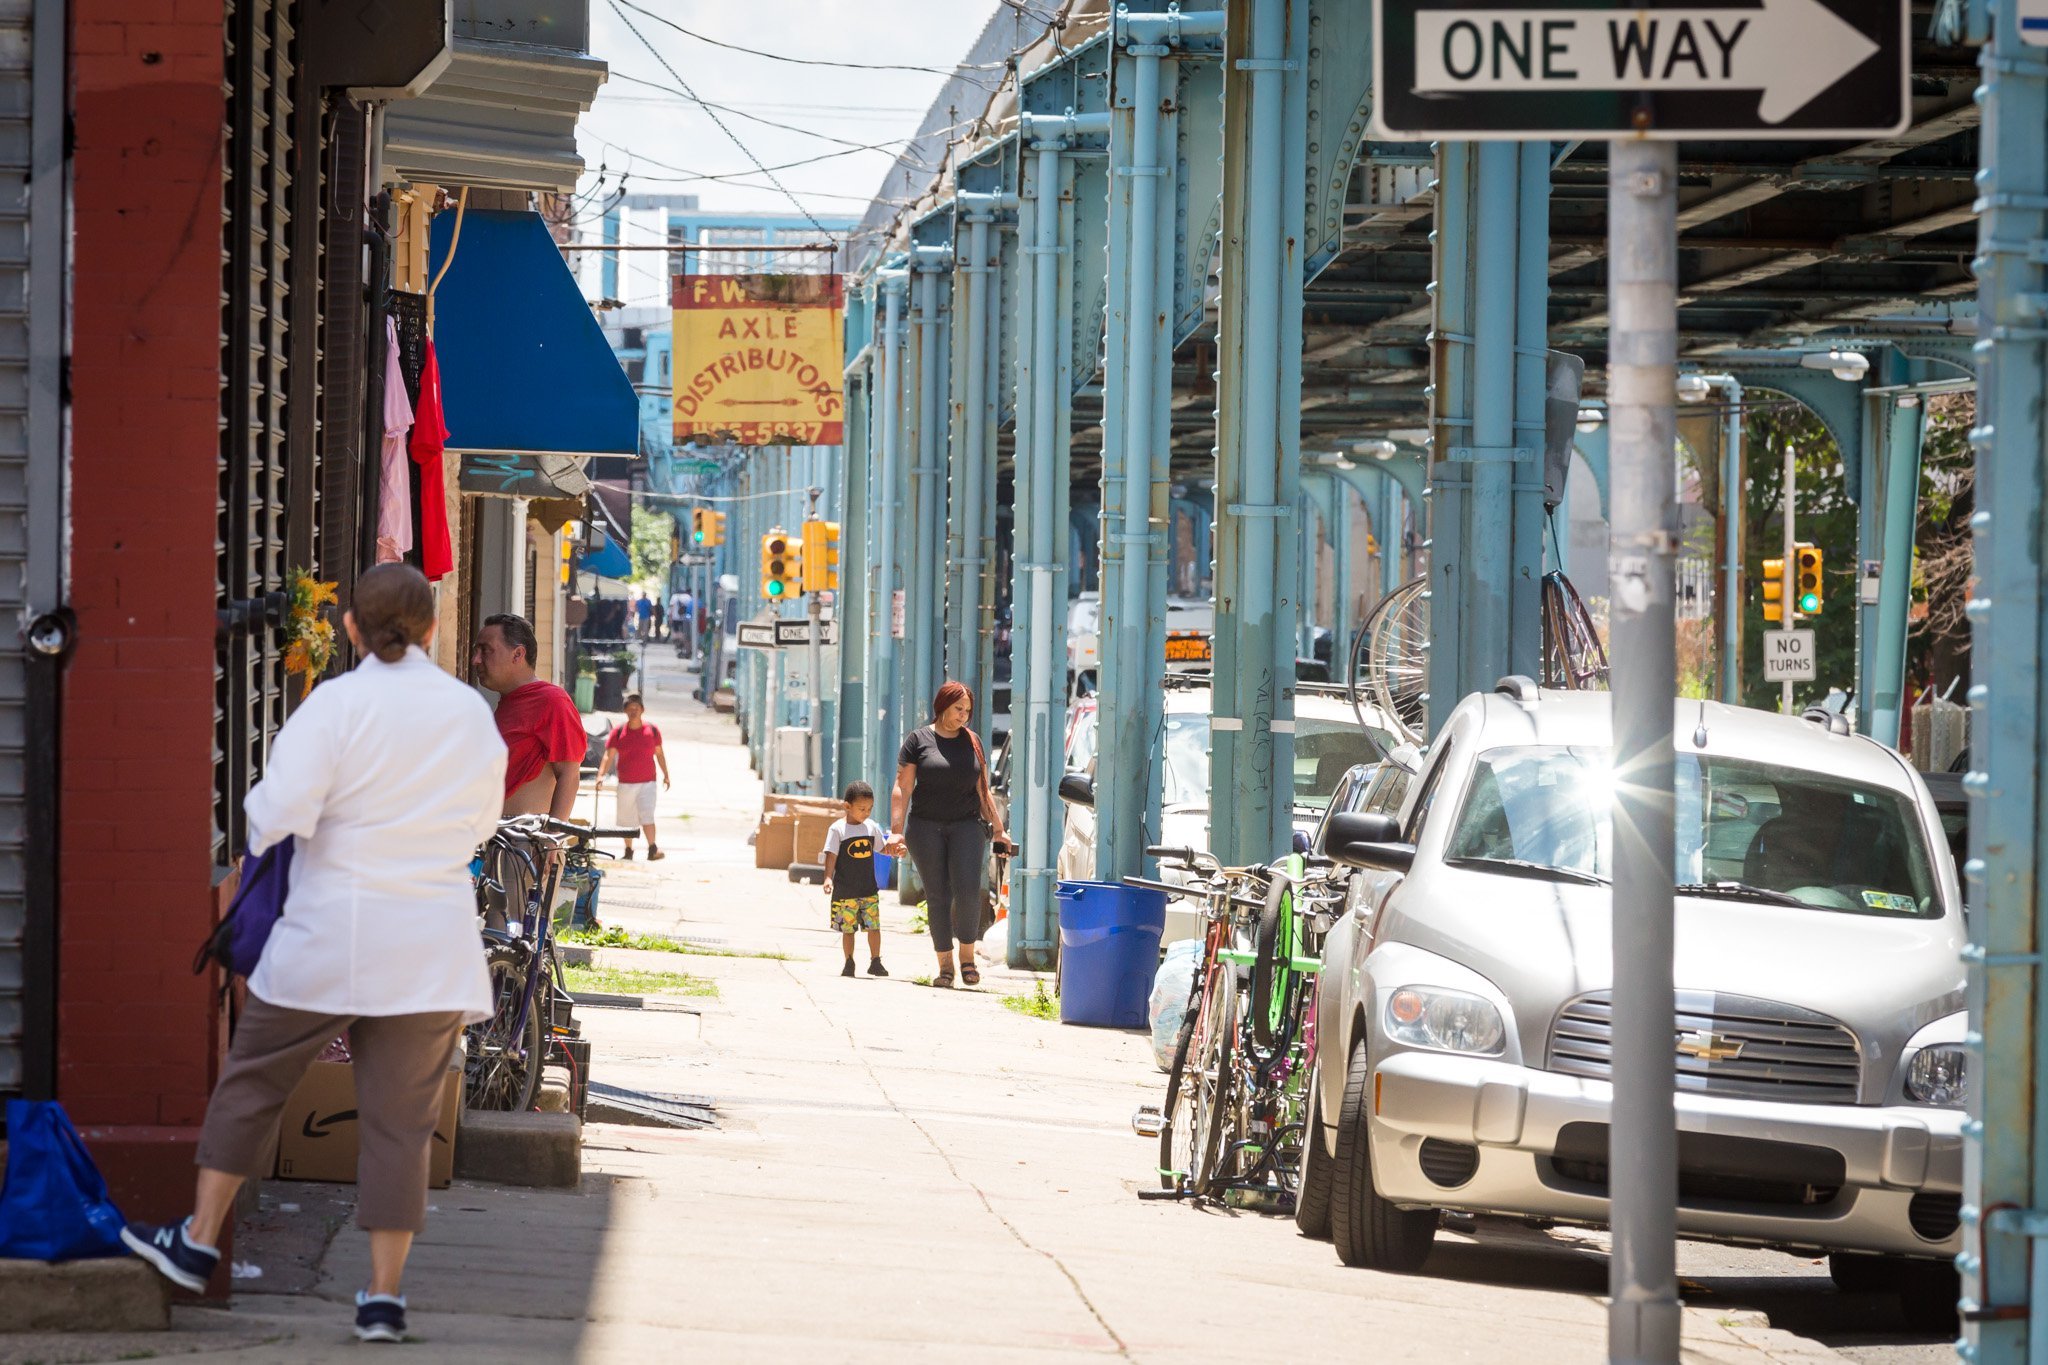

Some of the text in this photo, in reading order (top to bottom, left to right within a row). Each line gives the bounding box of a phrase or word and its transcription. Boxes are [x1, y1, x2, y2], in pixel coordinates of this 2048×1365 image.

[1442, 18, 1751, 81] ONE WAY
[718, 316, 798, 340] AXLE
[674, 348, 841, 417] DISTRIBUTORS
[782, 627, 804, 639] ONE
[1777, 638, 1801, 653] NO
[1769, 658, 1811, 672] TURNS
[153, 1226, 175, 1249] N
